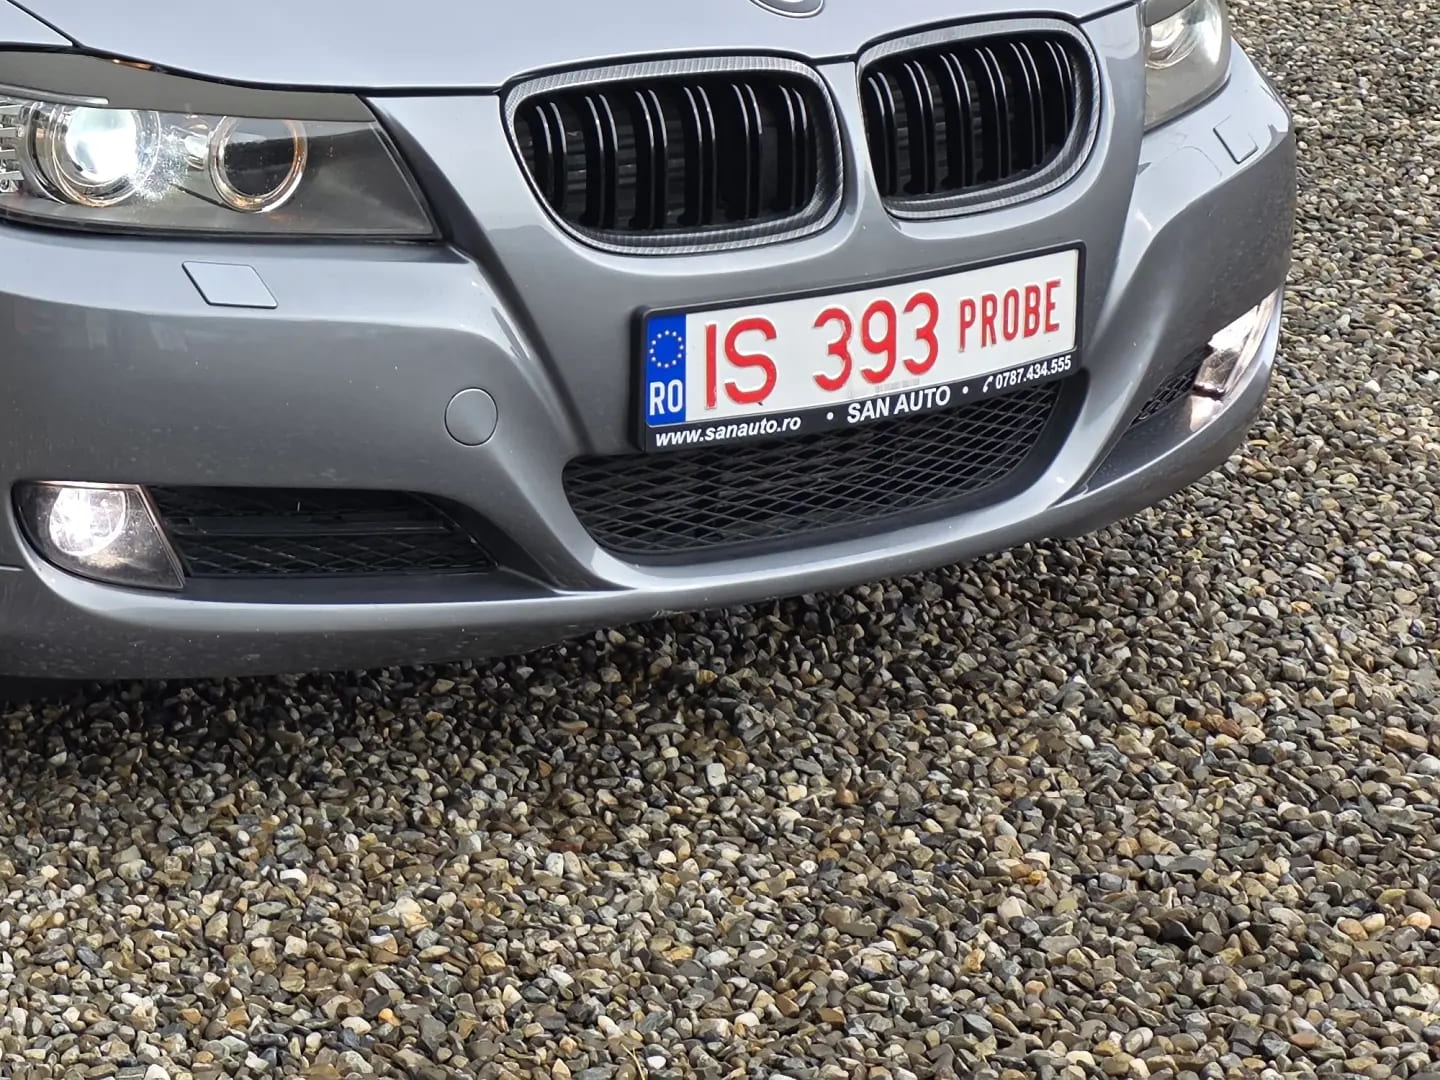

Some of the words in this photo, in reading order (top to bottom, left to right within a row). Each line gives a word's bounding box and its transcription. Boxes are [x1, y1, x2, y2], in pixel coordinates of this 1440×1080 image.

[705, 317, 777, 409] IS
[811, 291, 940, 392] 393
[958, 278, 1061, 352] PROBE
[648, 379, 683, 416] RO
[655, 416, 802, 447] www.sanauto.ro
[846, 396, 891, 423] SAN
[893, 385, 951, 415] AUTO
[994, 354, 1072, 390] 0787.434.555
